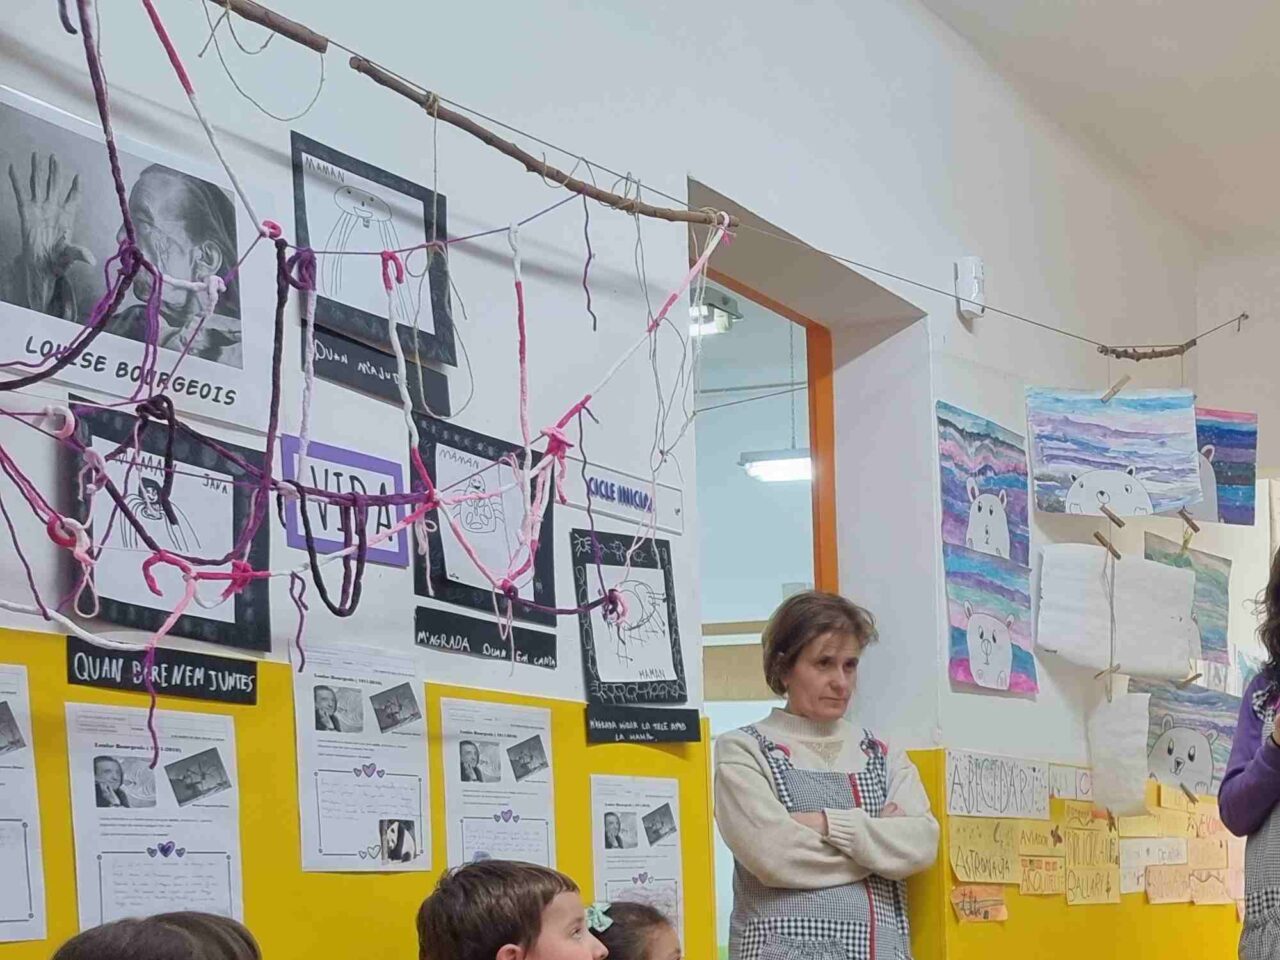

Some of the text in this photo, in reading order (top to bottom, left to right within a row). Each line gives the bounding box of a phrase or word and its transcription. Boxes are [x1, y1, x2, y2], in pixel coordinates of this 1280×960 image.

[304, 155, 346, 184] MAMAN
[25, 335, 237, 406] LOUSE BOURGEOIS
[438, 448, 481, 470] MAMAN
[309, 464, 393, 542] VIDA
[588, 476, 655, 514] CICLE INICIA
[417, 629, 471, 652] M'AGRADA
[73, 651, 124, 682] QUAN
[207, 669, 256, 693] JUNTES
